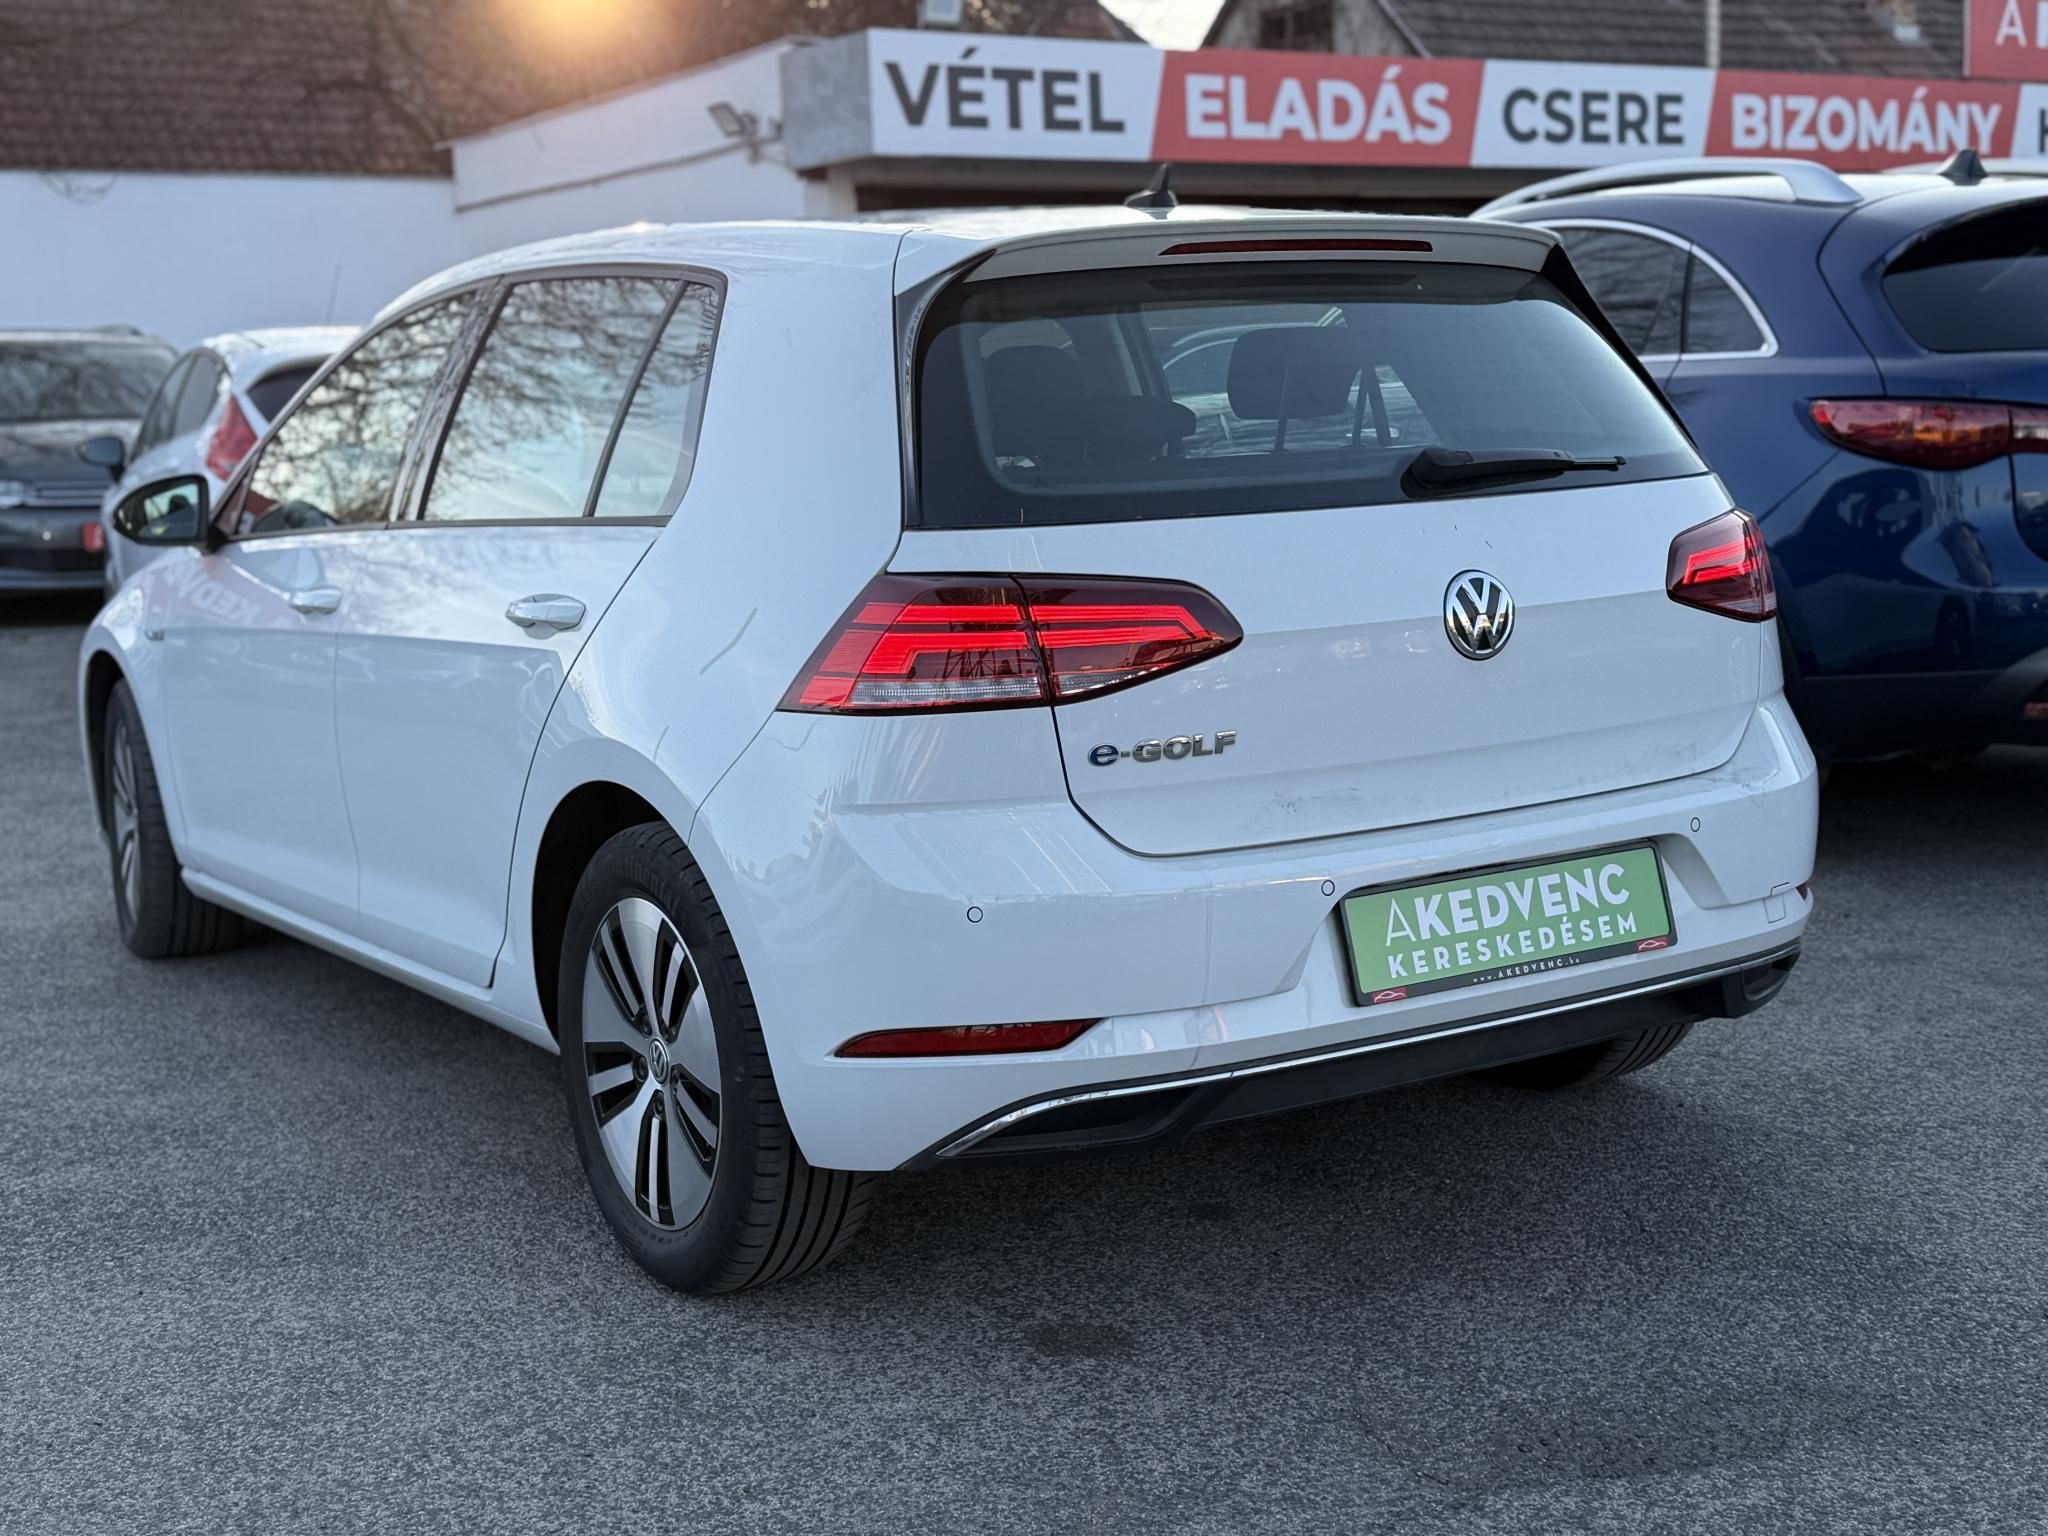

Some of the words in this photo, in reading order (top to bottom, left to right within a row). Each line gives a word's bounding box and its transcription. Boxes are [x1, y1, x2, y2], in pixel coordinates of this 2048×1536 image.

[885, 47, 1125, 133] VÉTEL
[1185, 66, 1451, 145] ELADÁS
[1503, 88, 1684, 145] CSERE
[1732, 86, 2002, 155] BIZOMÁNY
[1088, 729, 1237, 767] e-GOLF
[1385, 863, 1630, 946] AKEDVENC
[1388, 911, 1637, 979] KERESKEDÉSEM
